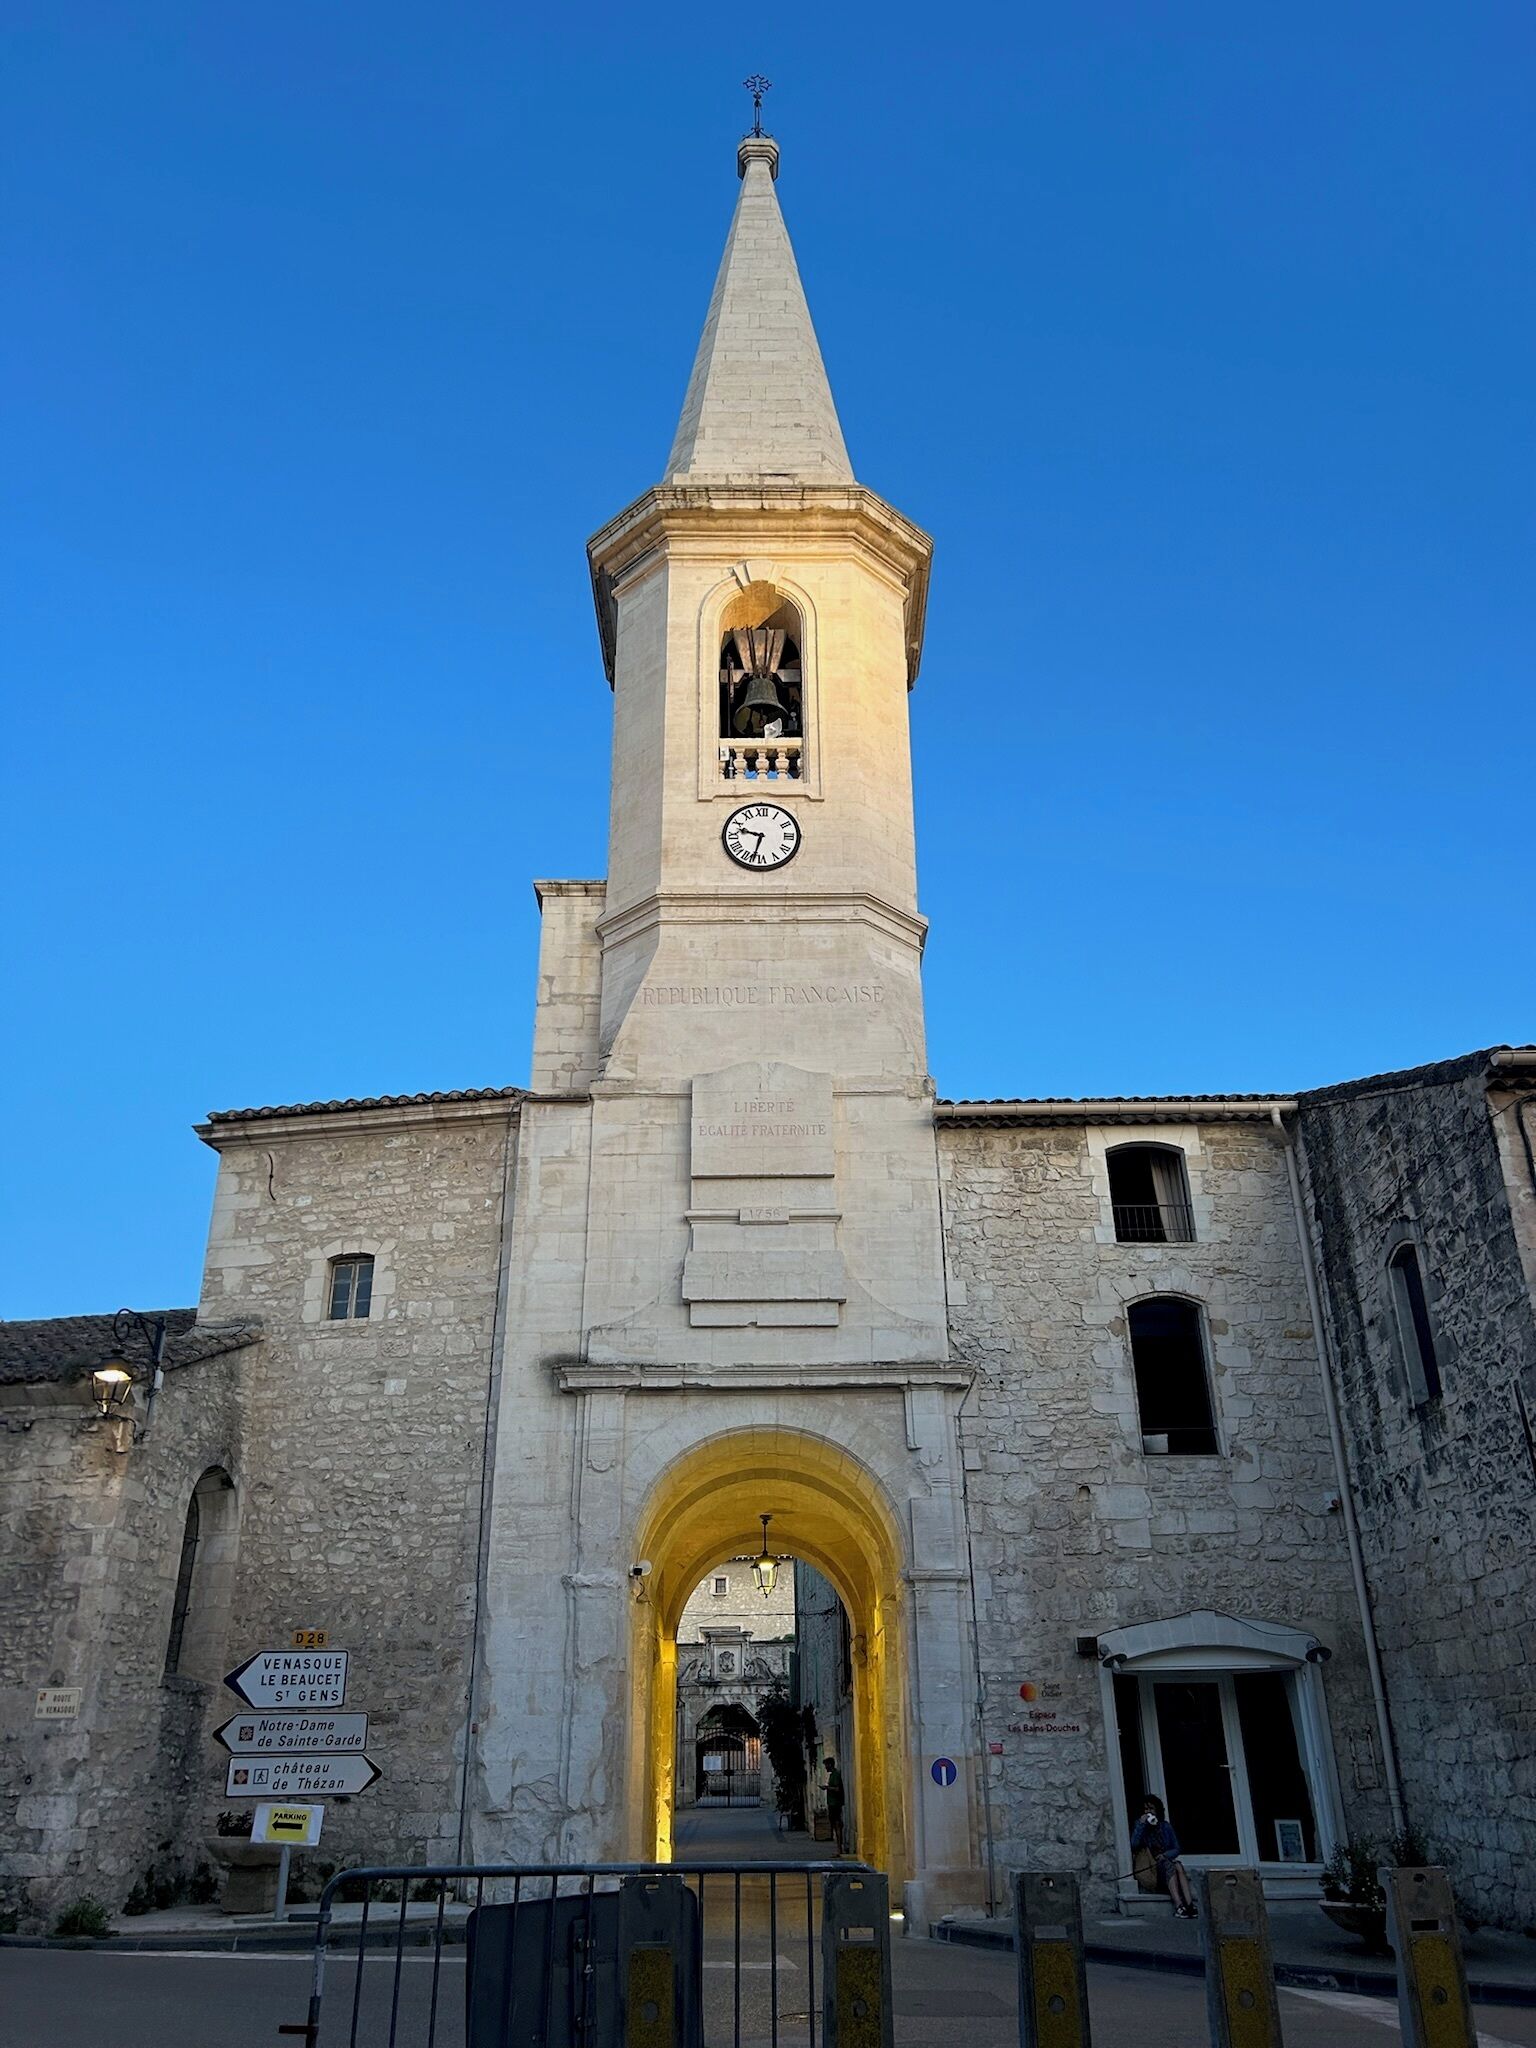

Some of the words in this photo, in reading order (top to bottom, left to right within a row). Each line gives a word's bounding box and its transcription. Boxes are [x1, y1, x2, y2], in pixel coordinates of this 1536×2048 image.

[742, 809, 754, 821] XI
[755, 808, 768, 817] XII
[732, 819, 744, 828] X
[780, 821, 791, 829] II
[728, 831, 740, 840] IX
[784, 832, 795, 841] III
[730, 841, 744, 856] VIII
[779, 844, 791, 855] IV
[758, 855, 767, 864] VI
[771, 852, 780, 862] V
[734, 1098, 795, 1112] LIBERTÉ
[752, 1120, 827, 1136] FRATERNITÉ
[295, 1633, 303, 1644] D
[307, 1632, 325, 1643] 28
[264, 1657, 342, 1670] VENASQUE
[261, 1674, 276, 1686] LE
[281, 1674, 341, 1686] BEAUCET
[298, 1690, 340, 1702] GENS
[46, 1706, 75, 1714] VENASQUE
[1029, 1710, 1057, 1721] Espace
[259, 1719, 335, 1732] Notre-Dame
[257, 1735, 273, 1747] de
[278, 1734, 362, 1748] Sainte-Garde
[274, 1761, 330, 1774] château
[272, 1778, 288, 1790] de
[298, 1777, 345, 1790] Thézan
